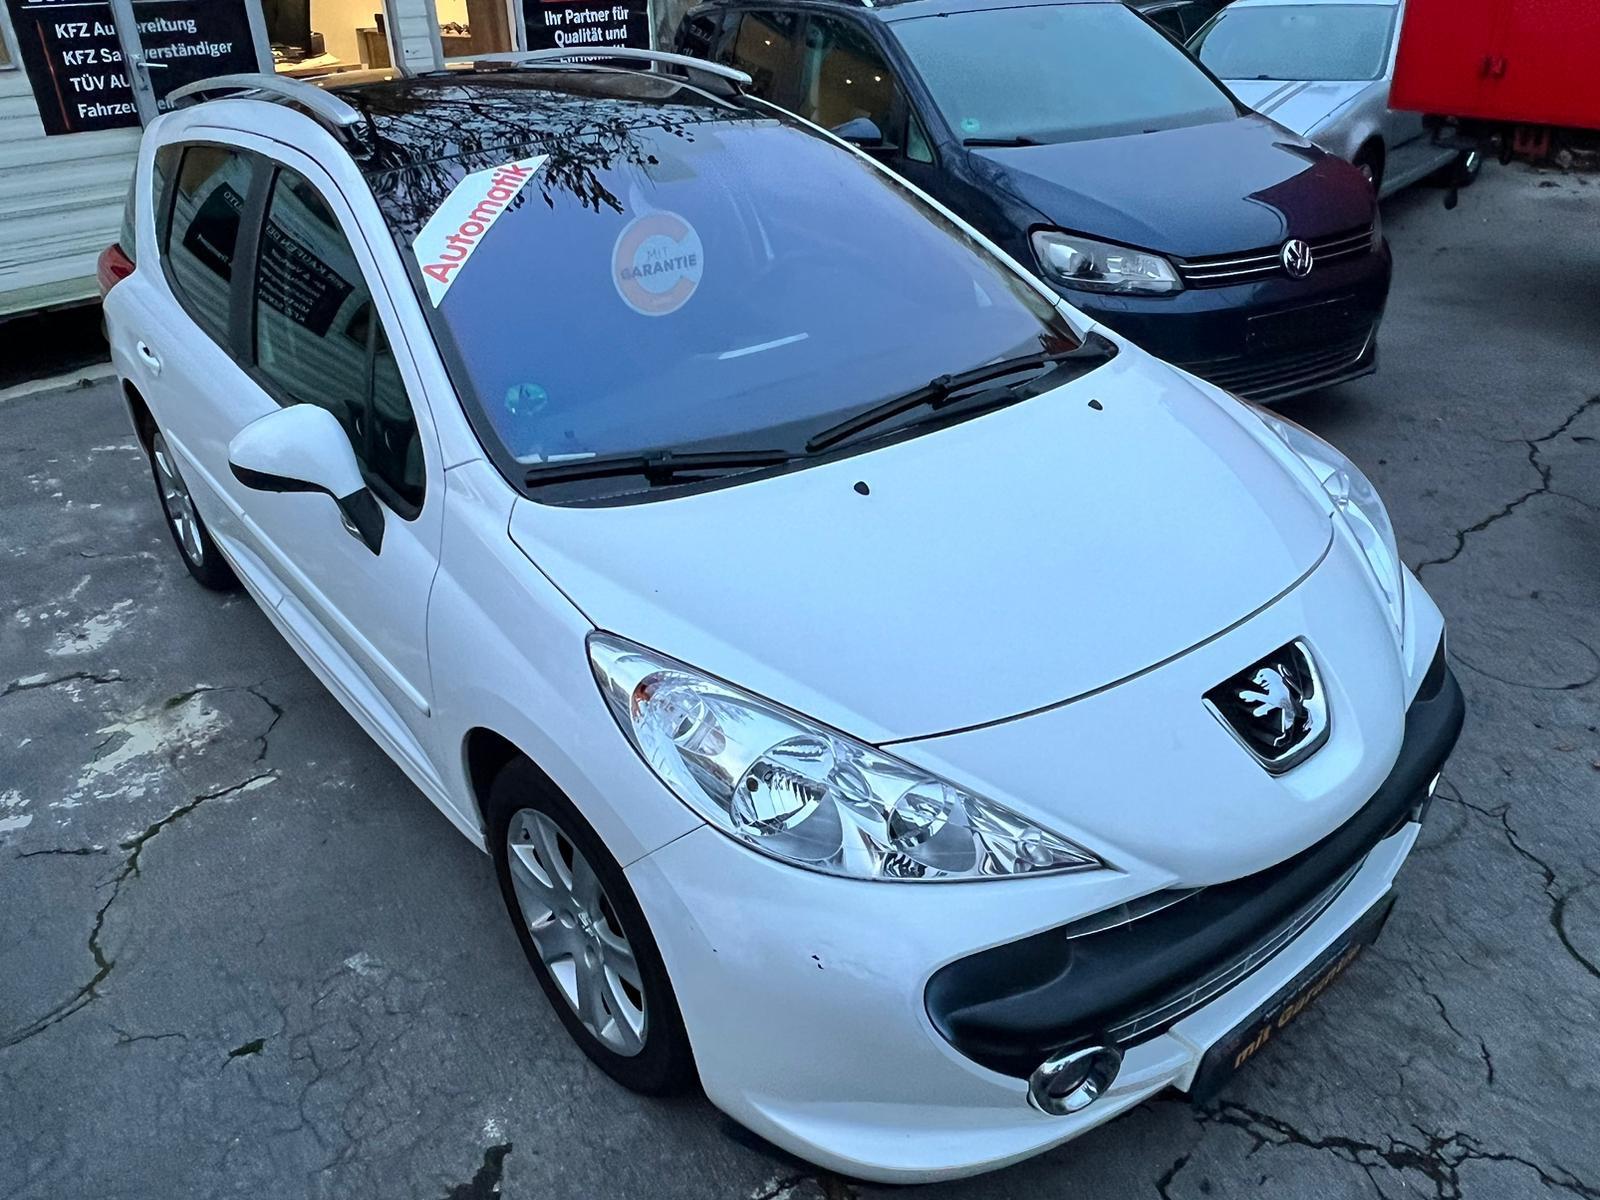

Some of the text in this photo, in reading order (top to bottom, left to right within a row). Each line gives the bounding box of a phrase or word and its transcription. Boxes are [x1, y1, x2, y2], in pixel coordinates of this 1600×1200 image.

[544, 6, 629, 26] Ihr Partner für
[55, 22, 90, 39] KFZ
[554, 25, 627, 48] Qualität und
[62, 49, 98, 66] KFZ
[69, 73, 104, 92] TÜV
[423, 164, 533, 284] Automatik
[647, 246, 669, 261] MIT
[621, 253, 697, 280] GARANTIE
